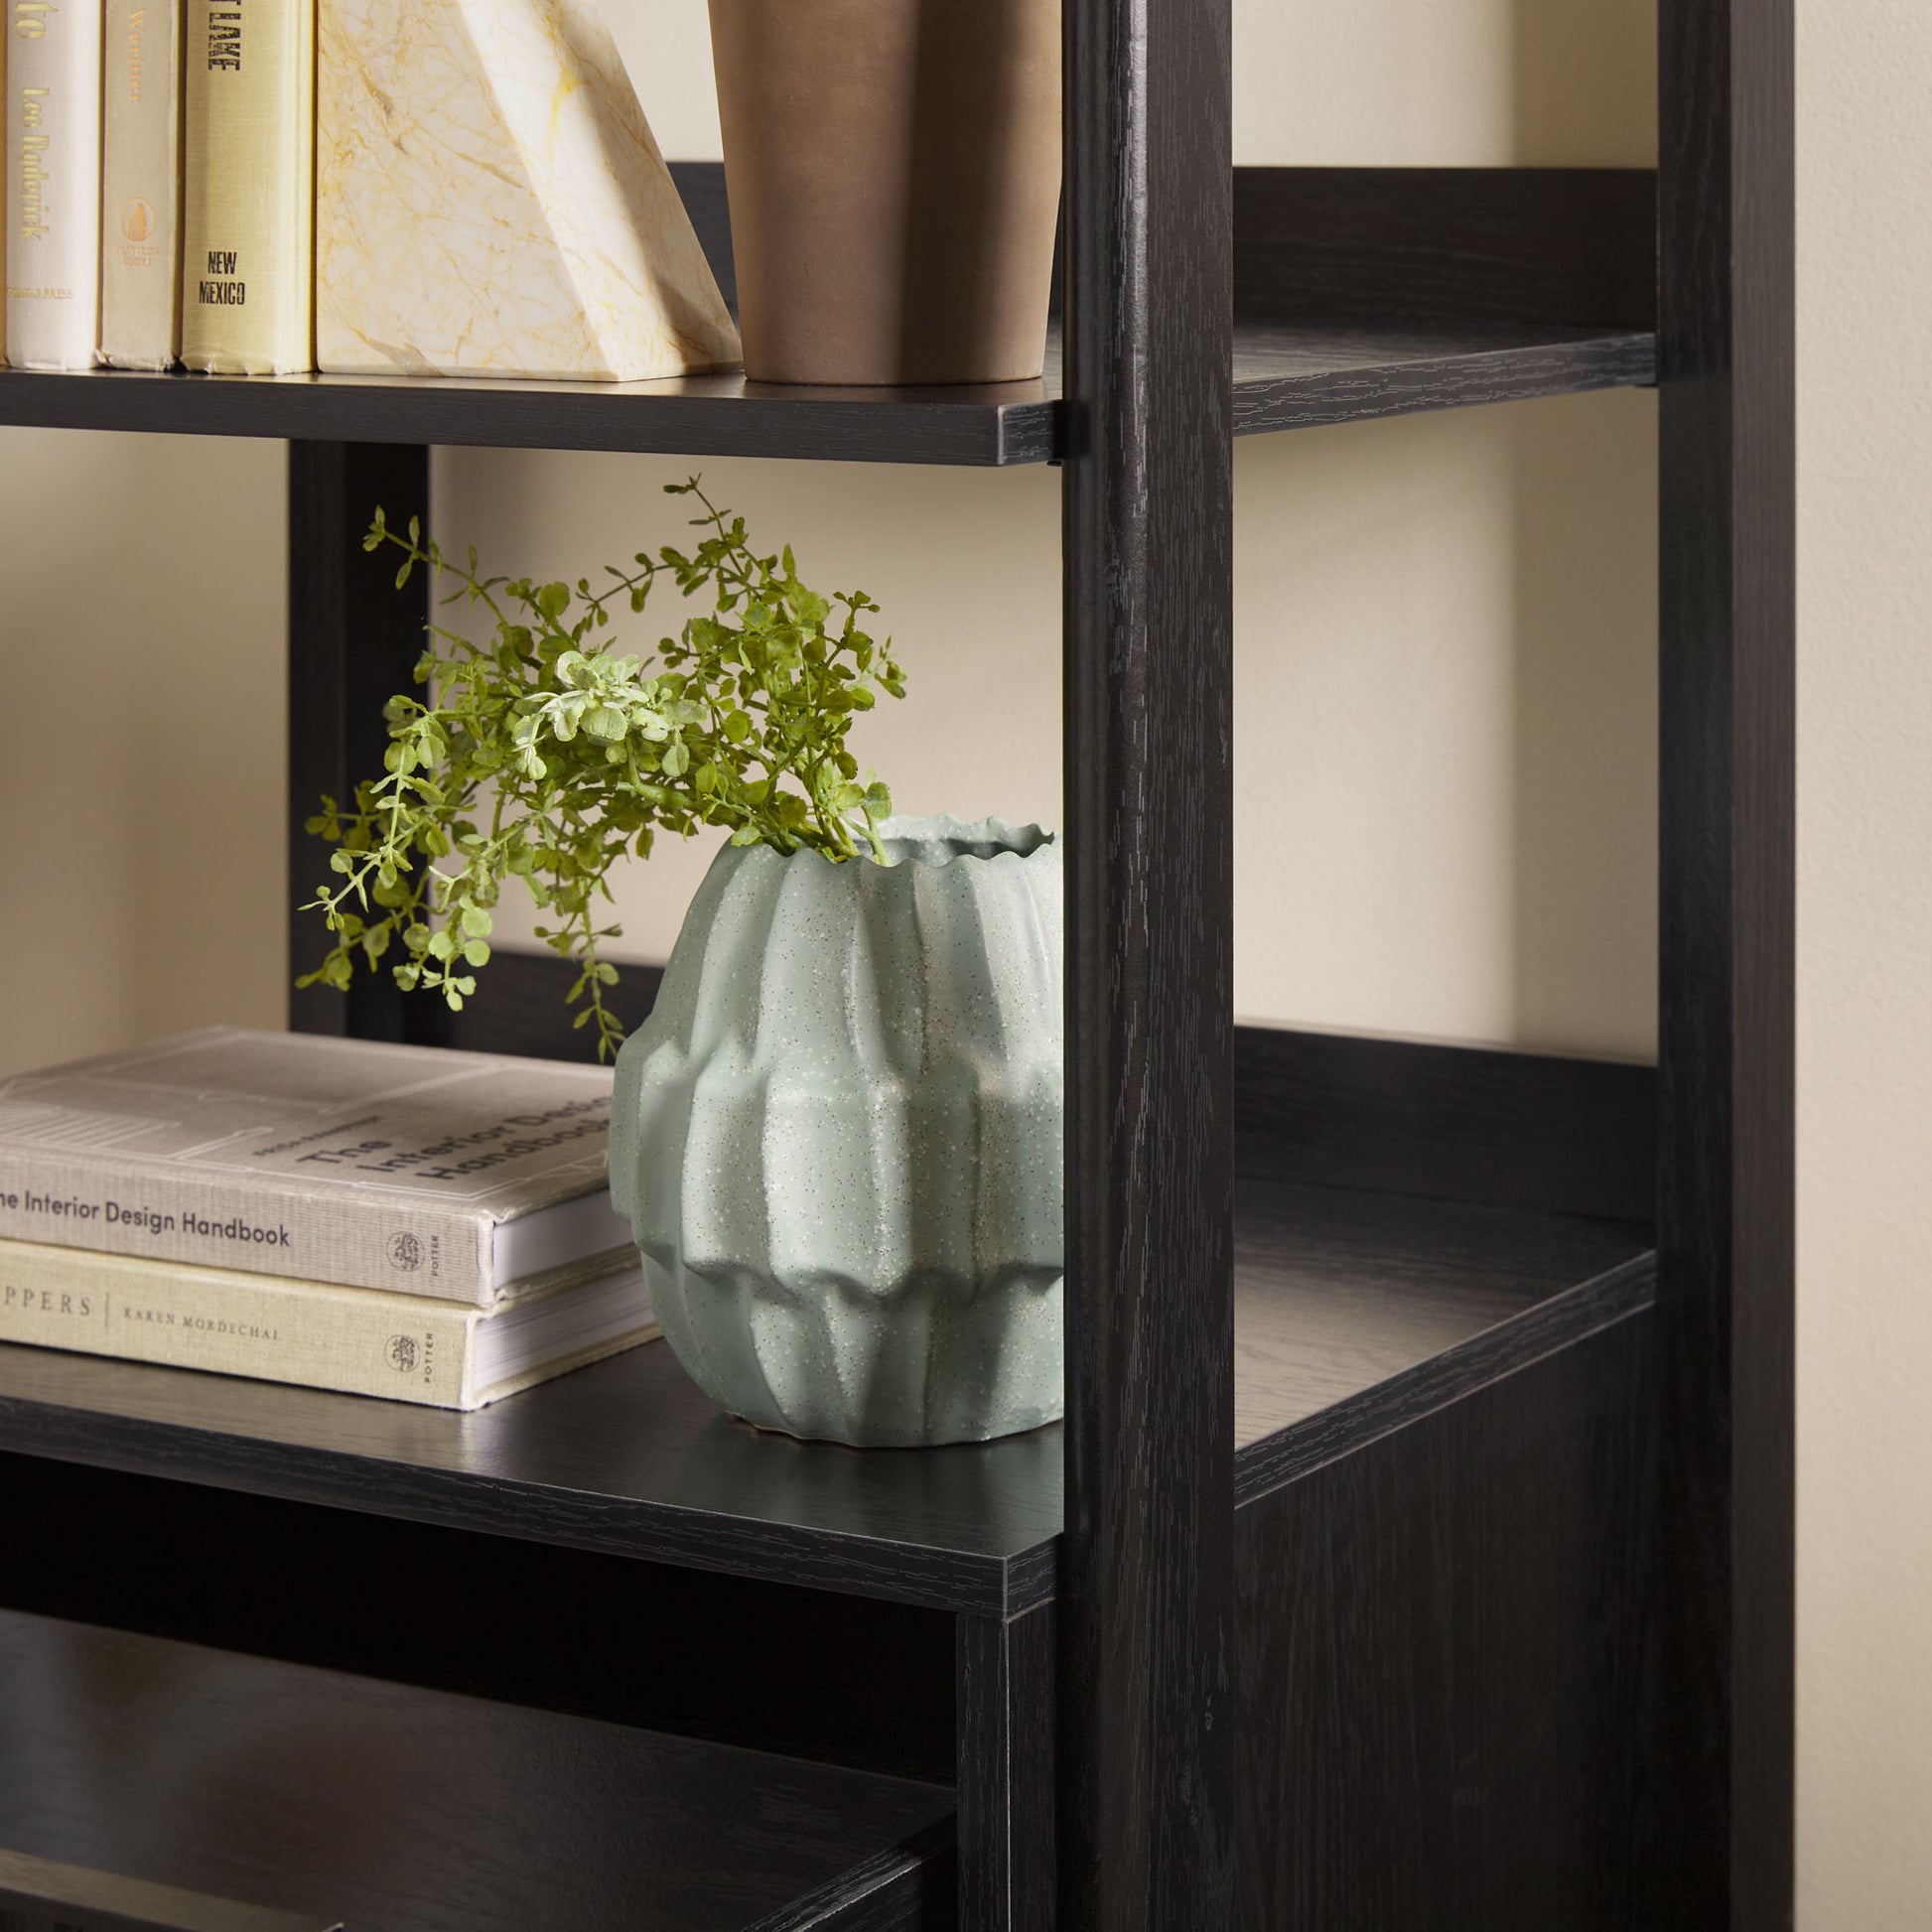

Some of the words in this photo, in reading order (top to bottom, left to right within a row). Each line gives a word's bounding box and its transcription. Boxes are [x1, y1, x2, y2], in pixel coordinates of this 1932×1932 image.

[208, 12, 241, 70] LAKE
[22, 87, 50, 129] Lee
[21, 135, 50, 240] Roderick
[207, 250, 237, 275] NEW
[199, 280, 245, 306] MEXICO
[295, 1139, 393, 1164] The
[355, 1124, 515, 1173] Interior
[25, 1189, 100, 1219] Interior
[105, 1201, 175, 1234] Design
[183, 1212, 291, 1246] Handbook
[431, 1234, 440, 1277] POTTER
[124, 1308, 176, 1325] KAREN
[183, 1316, 278, 1340] MORDECHAI
[424, 1332, 434, 1384] POTTER
